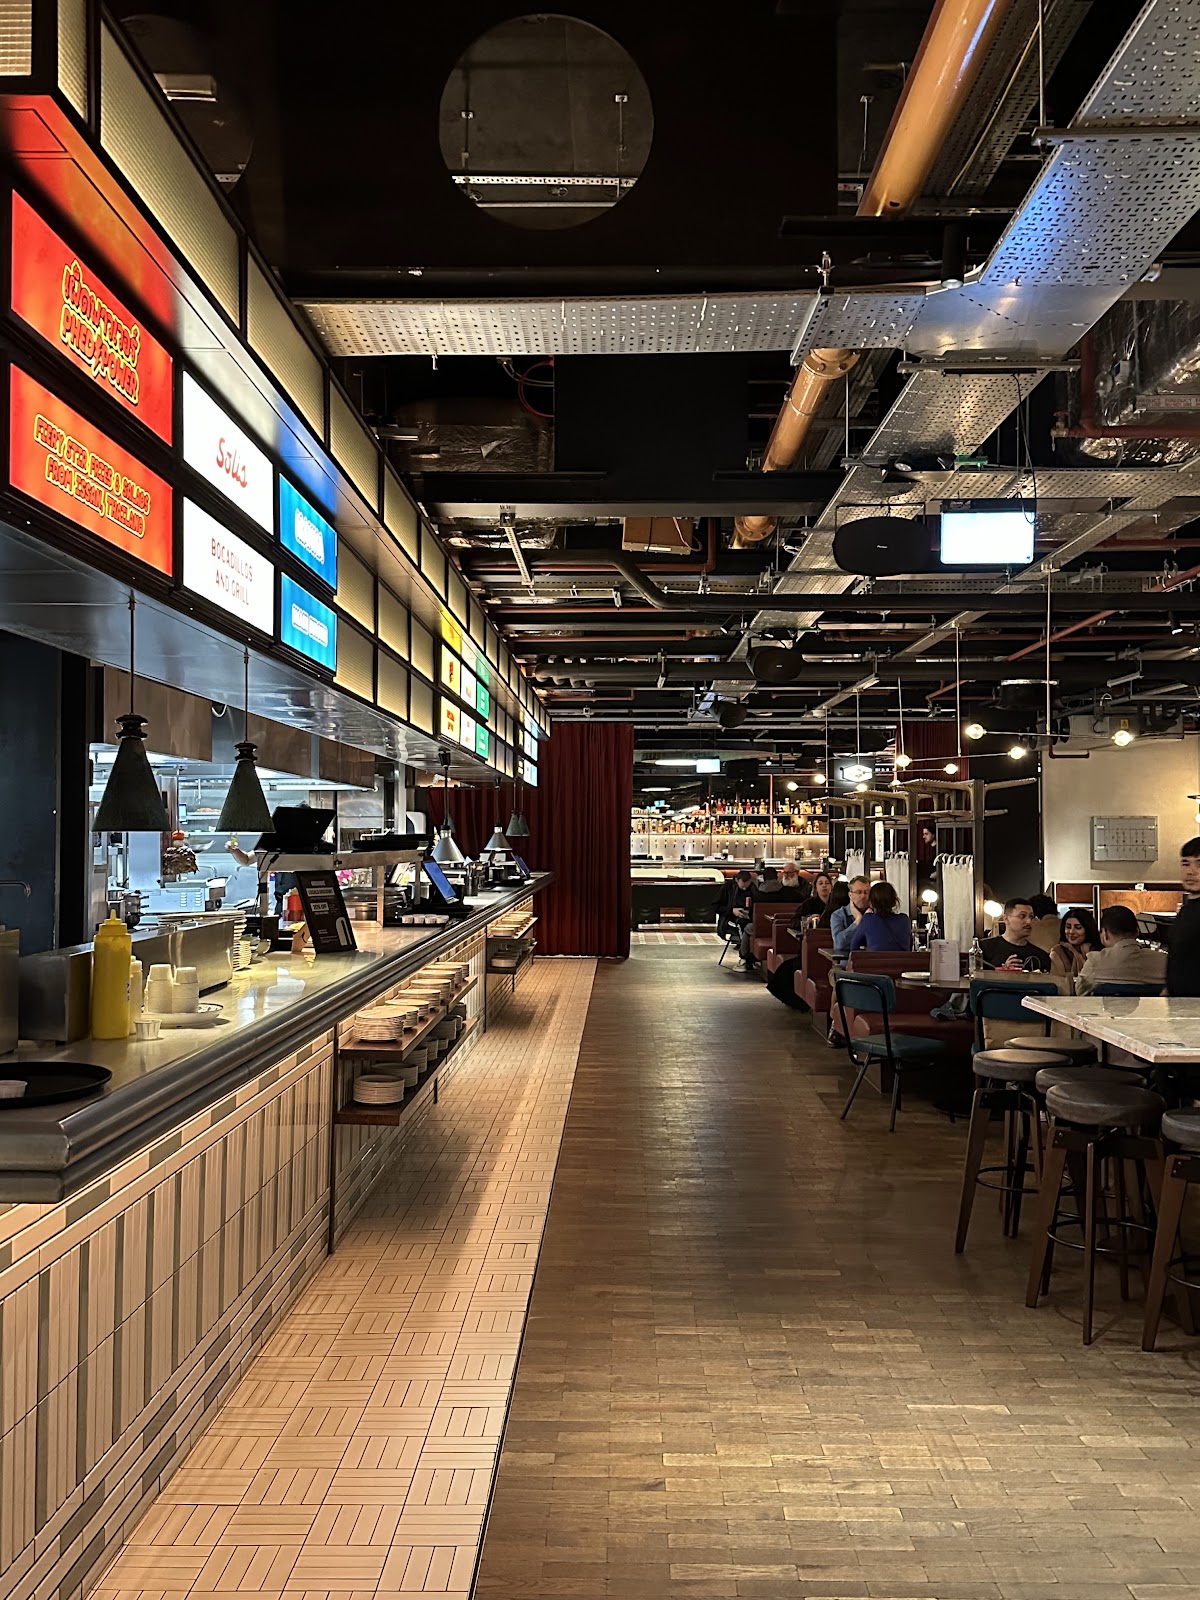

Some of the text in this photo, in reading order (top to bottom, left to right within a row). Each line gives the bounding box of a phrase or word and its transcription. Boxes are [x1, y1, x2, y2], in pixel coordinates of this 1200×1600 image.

[61, 305, 139, 402] PHED POWER
[35, 415, 150, 514] FIERY STIR FRIES & SALADS
[46, 455, 145, 536] FROM ISSAN, THAILAND
[216, 437, 248, 488] Solis
[211, 537, 253, 582] BOCADILLOS
[215, 569, 249, 605] AND GRILL
